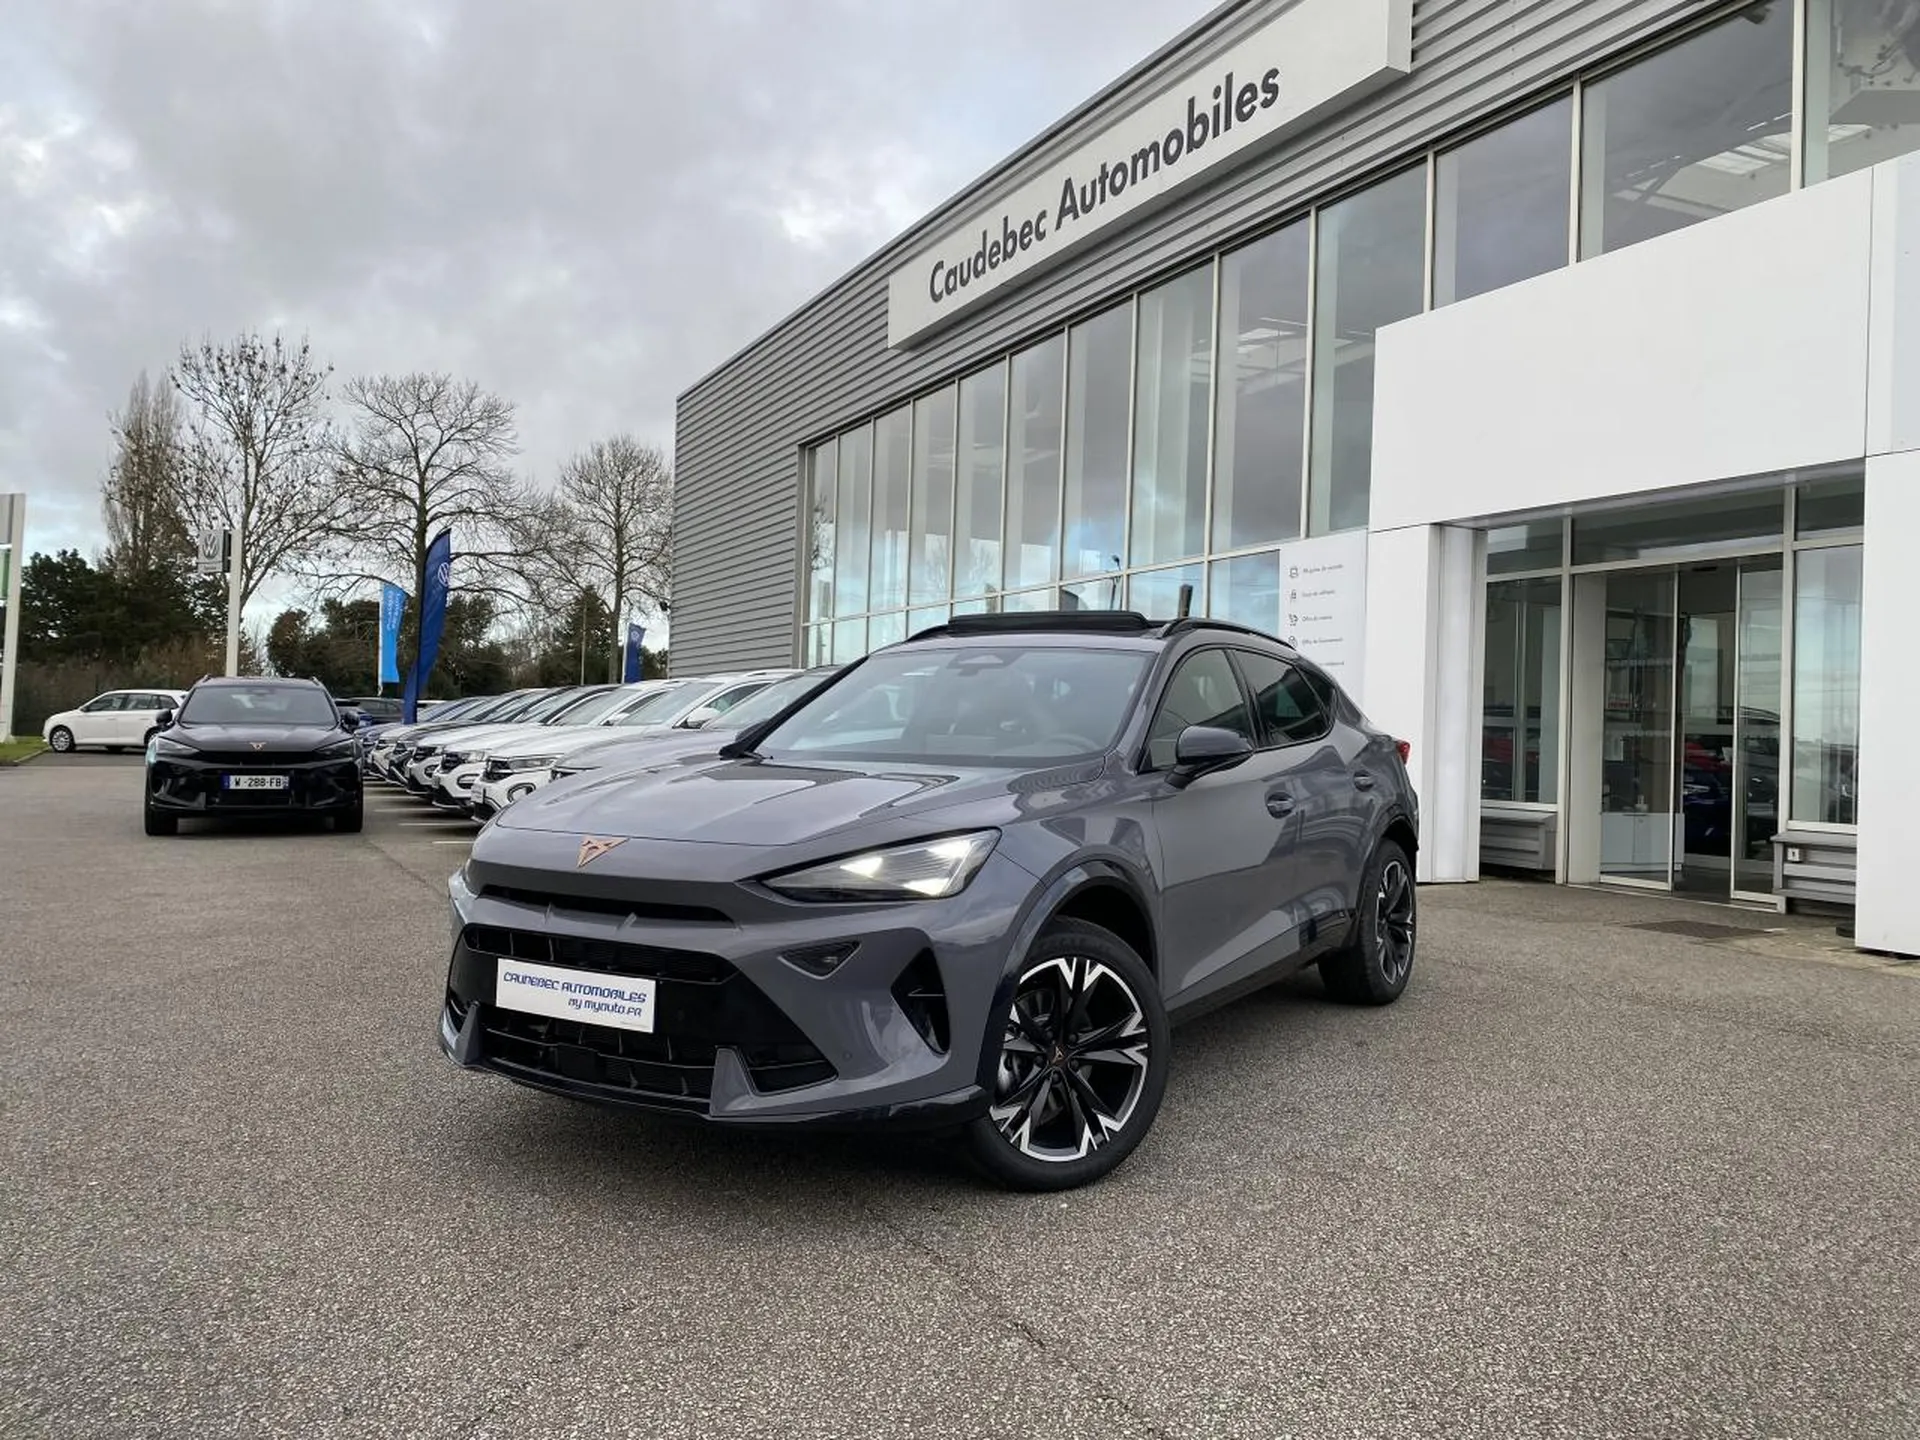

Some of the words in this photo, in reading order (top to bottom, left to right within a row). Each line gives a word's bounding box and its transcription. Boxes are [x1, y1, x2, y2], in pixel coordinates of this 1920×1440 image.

[929, 206, 1048, 303] Caudebec
[1055, 67, 1280, 231] Automobiles
[503, 971, 561, 991] CAUDEBEC
[561, 981, 648, 1004] AUTOMOBILES
